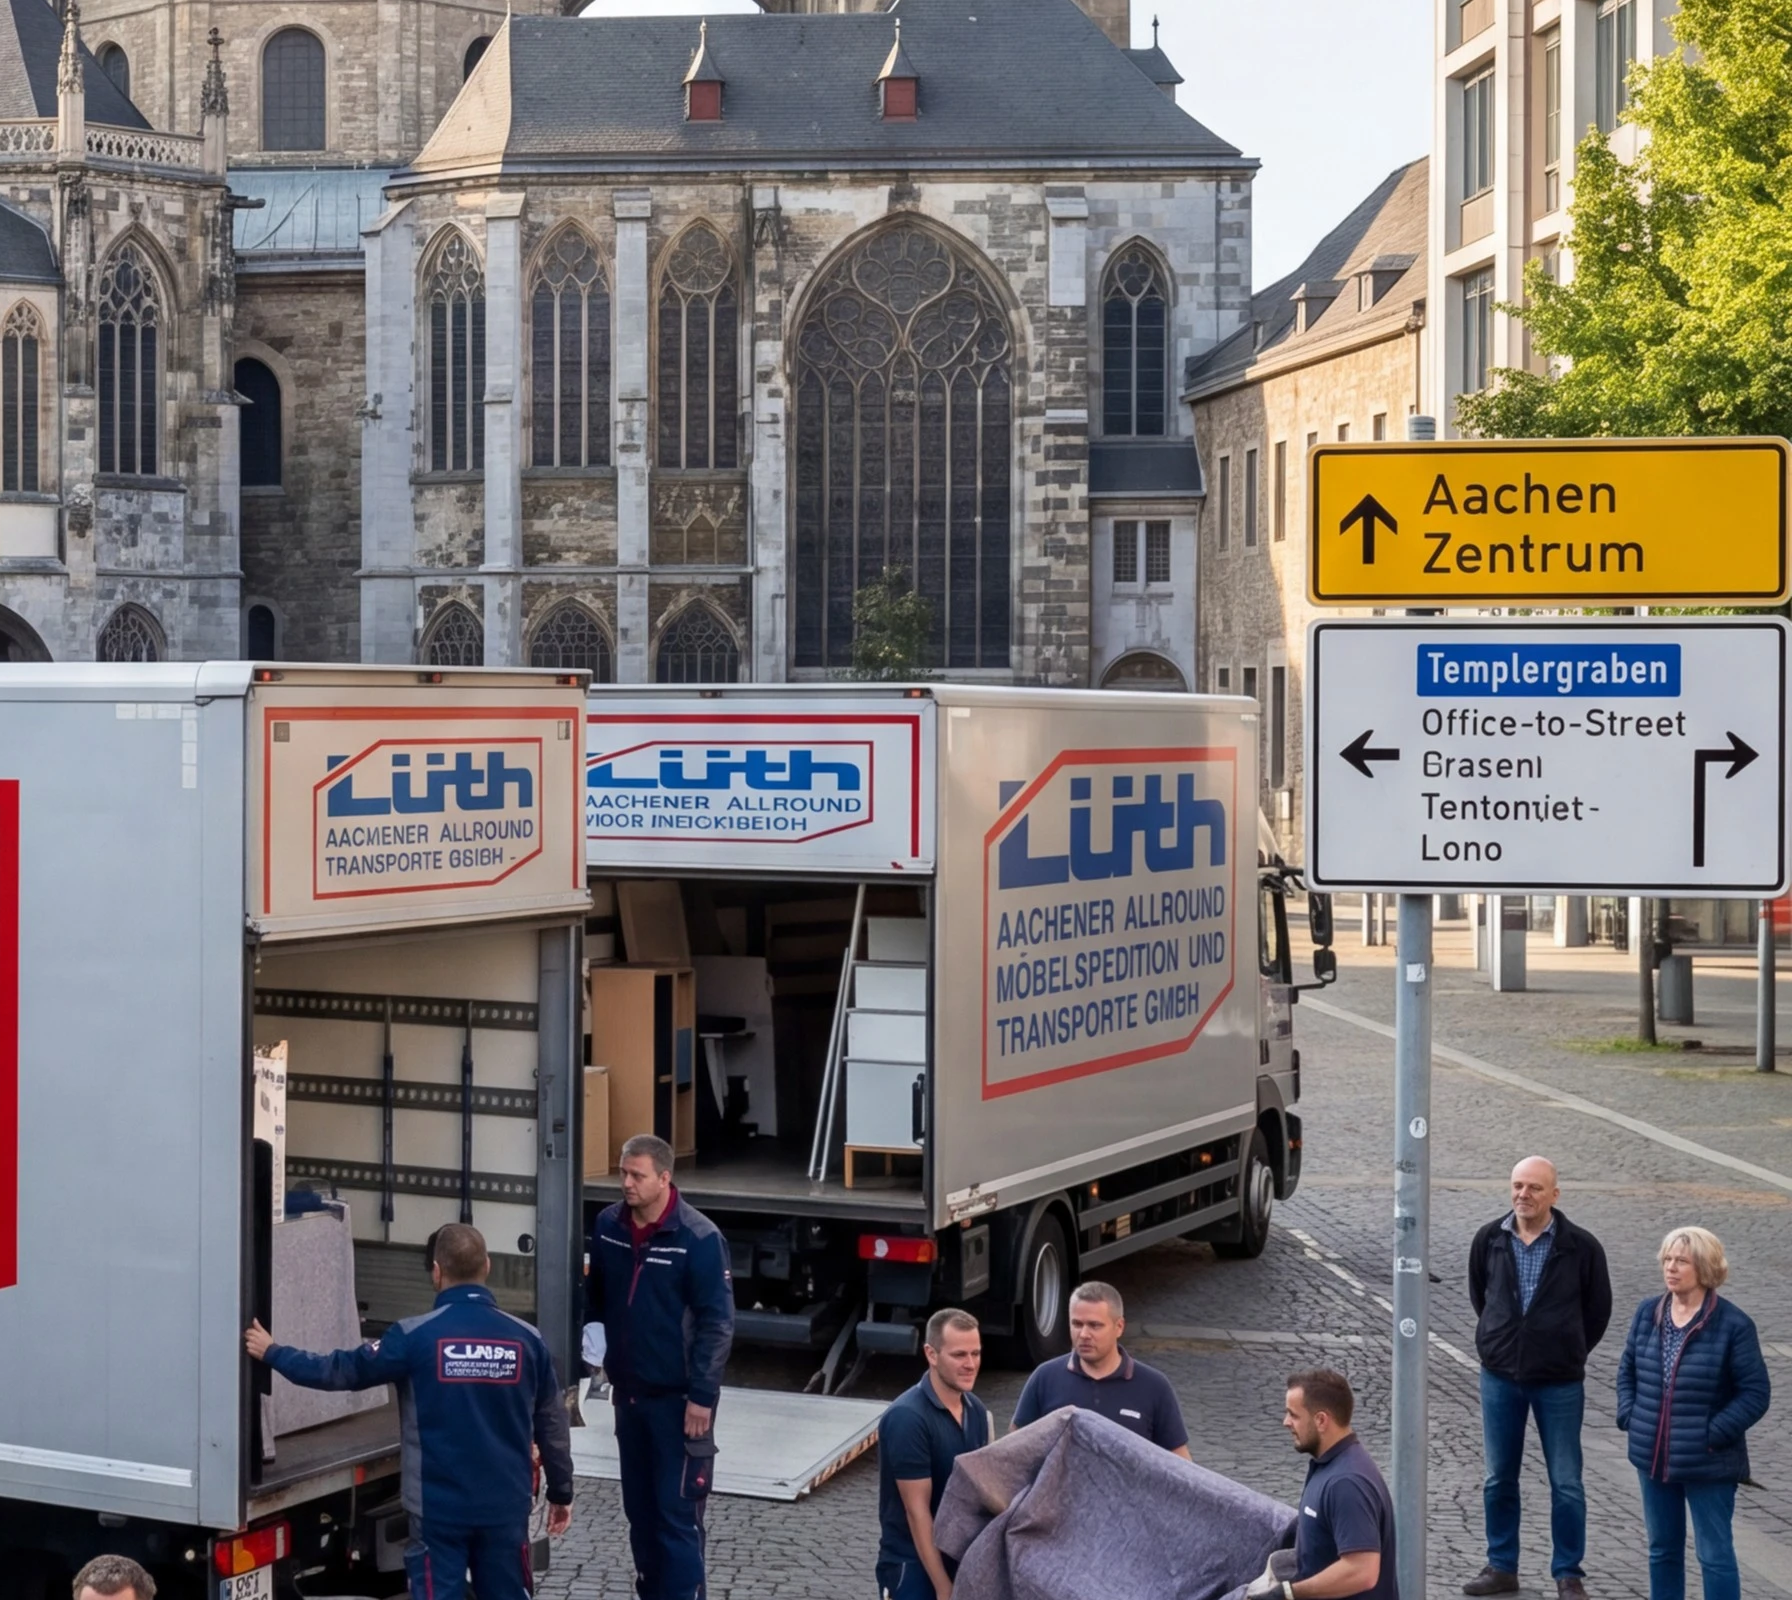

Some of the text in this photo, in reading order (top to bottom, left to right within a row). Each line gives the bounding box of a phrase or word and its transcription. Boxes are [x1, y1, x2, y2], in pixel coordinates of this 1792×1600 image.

[1422, 472, 1616, 515] Aachen
[1422, 533, 1645, 574] Zentrum
[1427, 652, 1668, 694] Templergraben
[1422, 708, 1686, 737] Office-to-Street
[327, 751, 533, 818] Lüth
[727, 796, 862, 813] ALLROUND
[439, 819, 534, 844] ALLROUND
[999, 773, 1226, 890] Lüth
[1421, 834, 1503, 862] Lono
[325, 851, 443, 877] TRANSPORTE
[996, 885, 1225, 951] AACHENER ALLROUND
[1189, 931, 1225, 969] UND
[996, 981, 1200, 1057] TRANSPORTE GMBH
